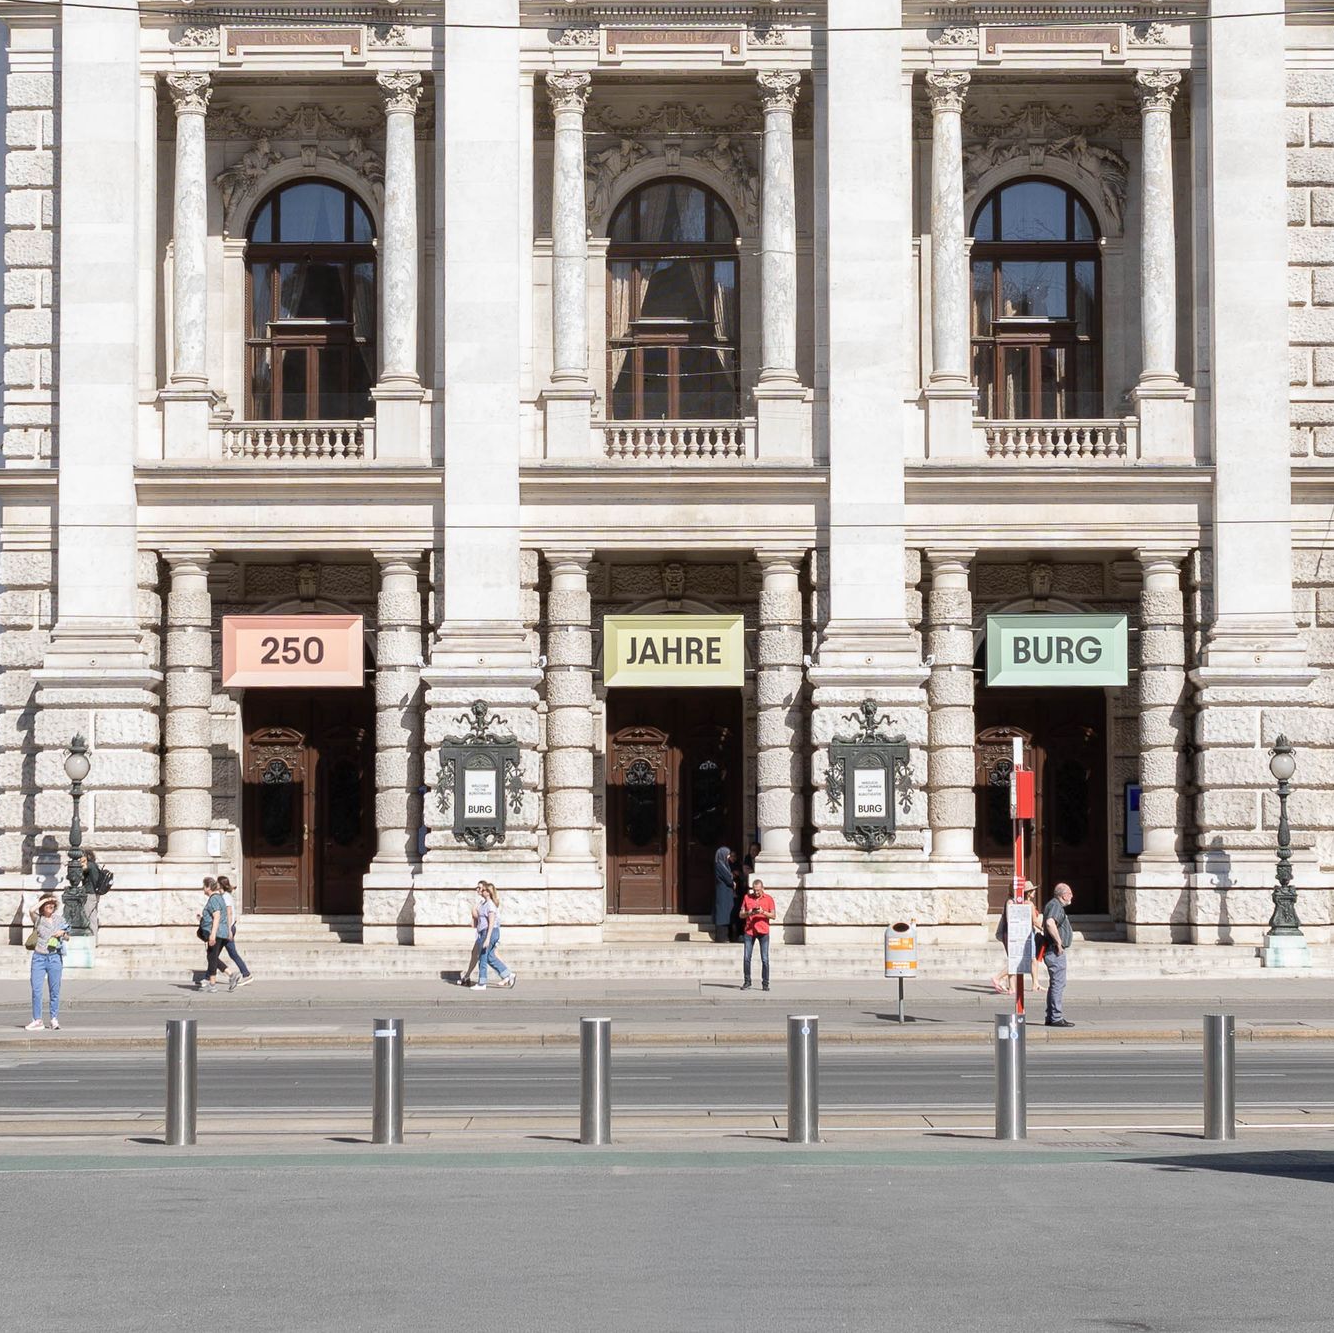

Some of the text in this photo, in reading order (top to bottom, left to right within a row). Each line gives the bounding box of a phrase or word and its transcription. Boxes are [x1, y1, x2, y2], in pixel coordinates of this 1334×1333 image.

[264, 32, 322, 43] LESSING
[261, 636, 324, 665] 250
[626, 637, 722, 664] JAHRE
[1013, 636, 1102, 664] BURG
[468, 805, 493, 814] BURG
[858, 804, 883, 813] BURG
